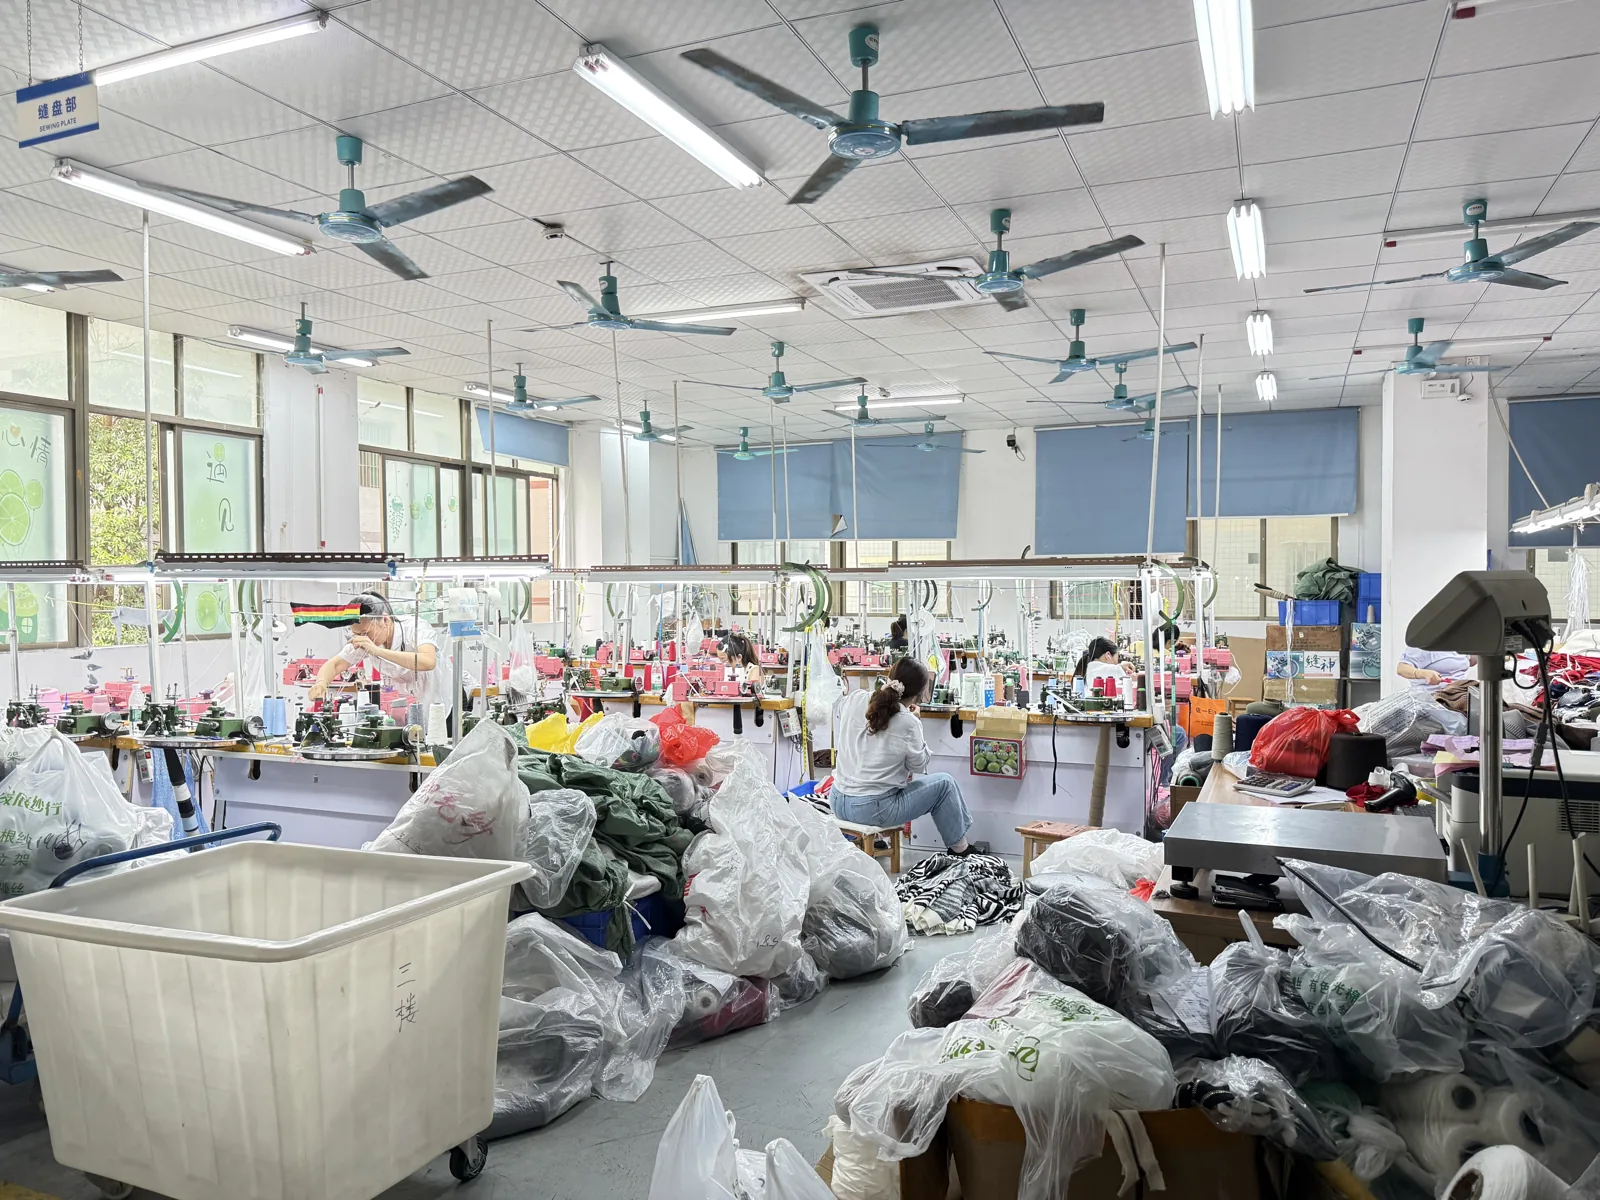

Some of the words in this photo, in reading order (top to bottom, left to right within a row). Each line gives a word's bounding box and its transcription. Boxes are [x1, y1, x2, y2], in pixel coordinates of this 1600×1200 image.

[38, 96, 76, 119] 缝盘部
[39, 122, 60, 132] SEWING
[60, 117, 77, 127] PLATE
